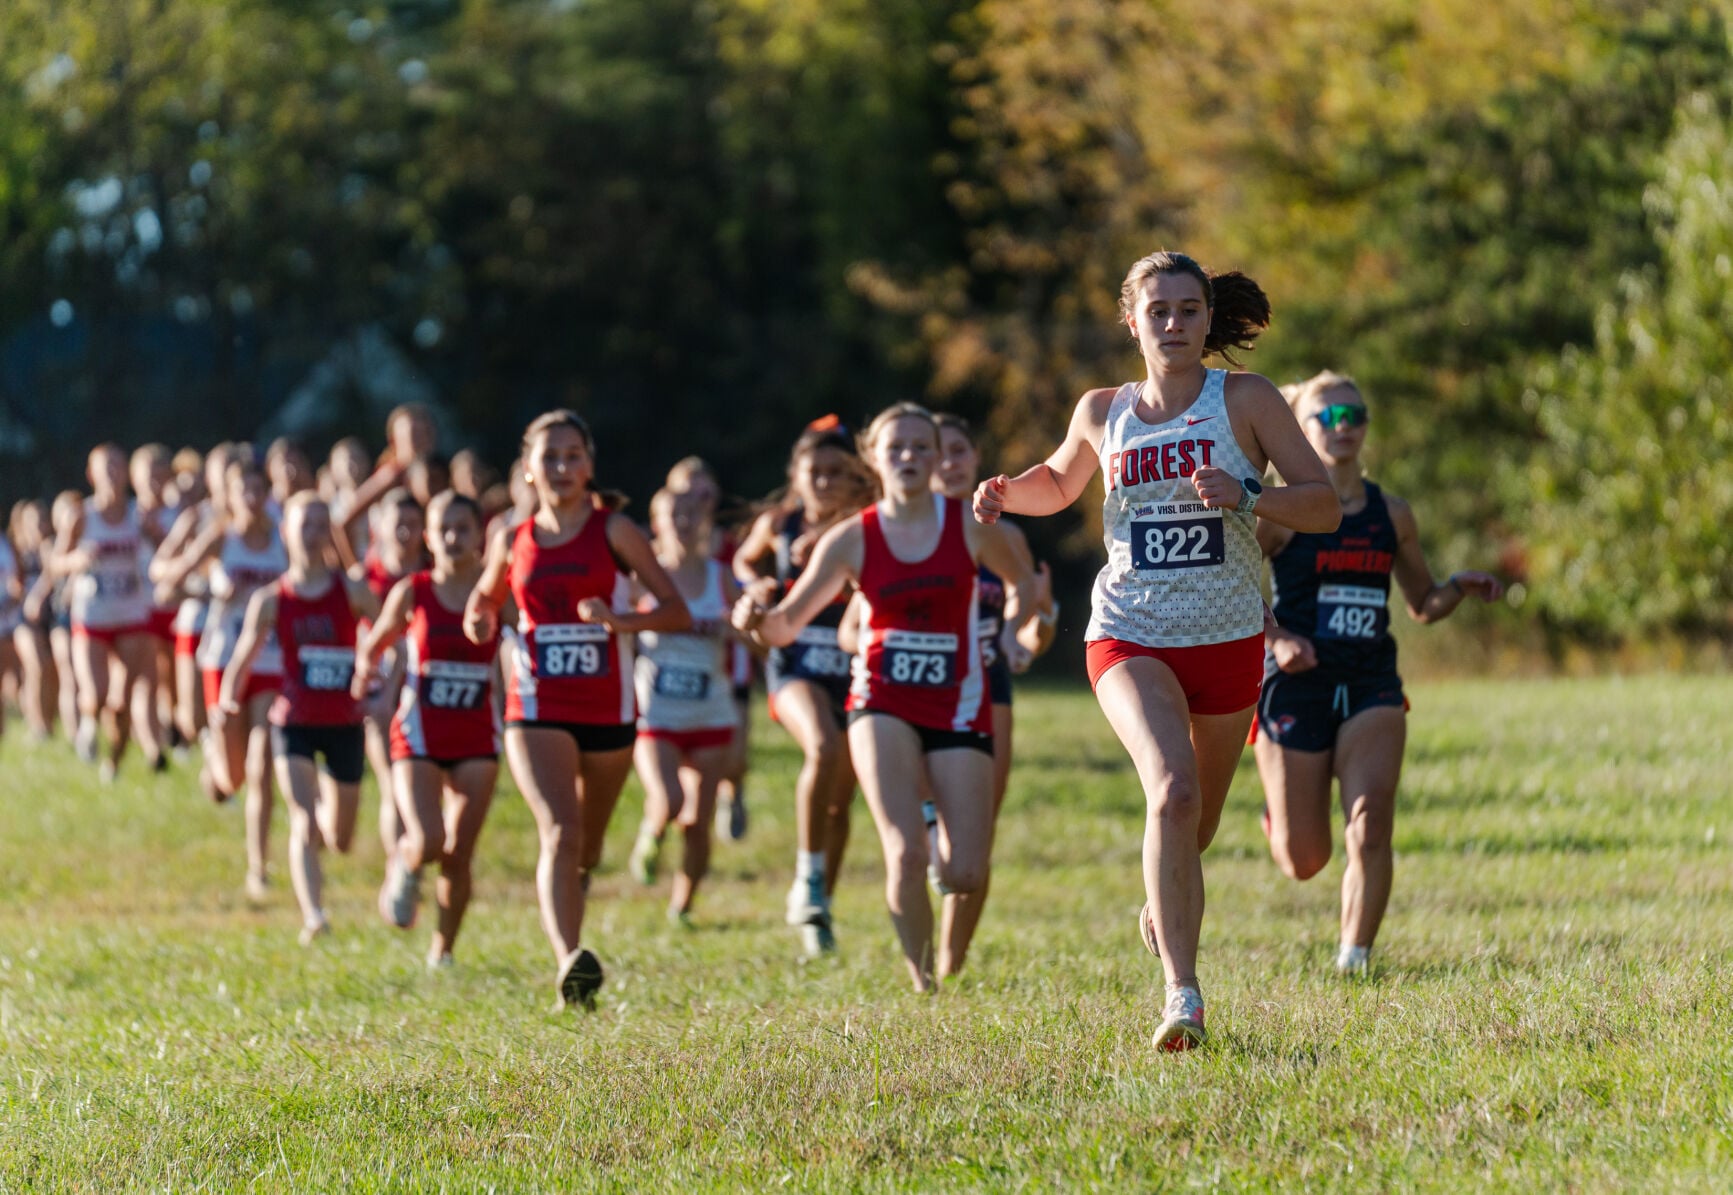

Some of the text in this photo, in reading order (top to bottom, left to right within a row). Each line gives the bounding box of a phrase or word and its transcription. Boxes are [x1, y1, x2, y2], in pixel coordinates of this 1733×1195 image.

[1109, 439, 1215, 491] FOREST
[1158, 505, 1177, 515] VHSL
[1145, 525, 1211, 564] 822
[1327, 606, 1377, 637] 492
[545, 643, 599, 675] 879
[891, 651, 946, 684] 873
[429, 679, 480, 706] 877
